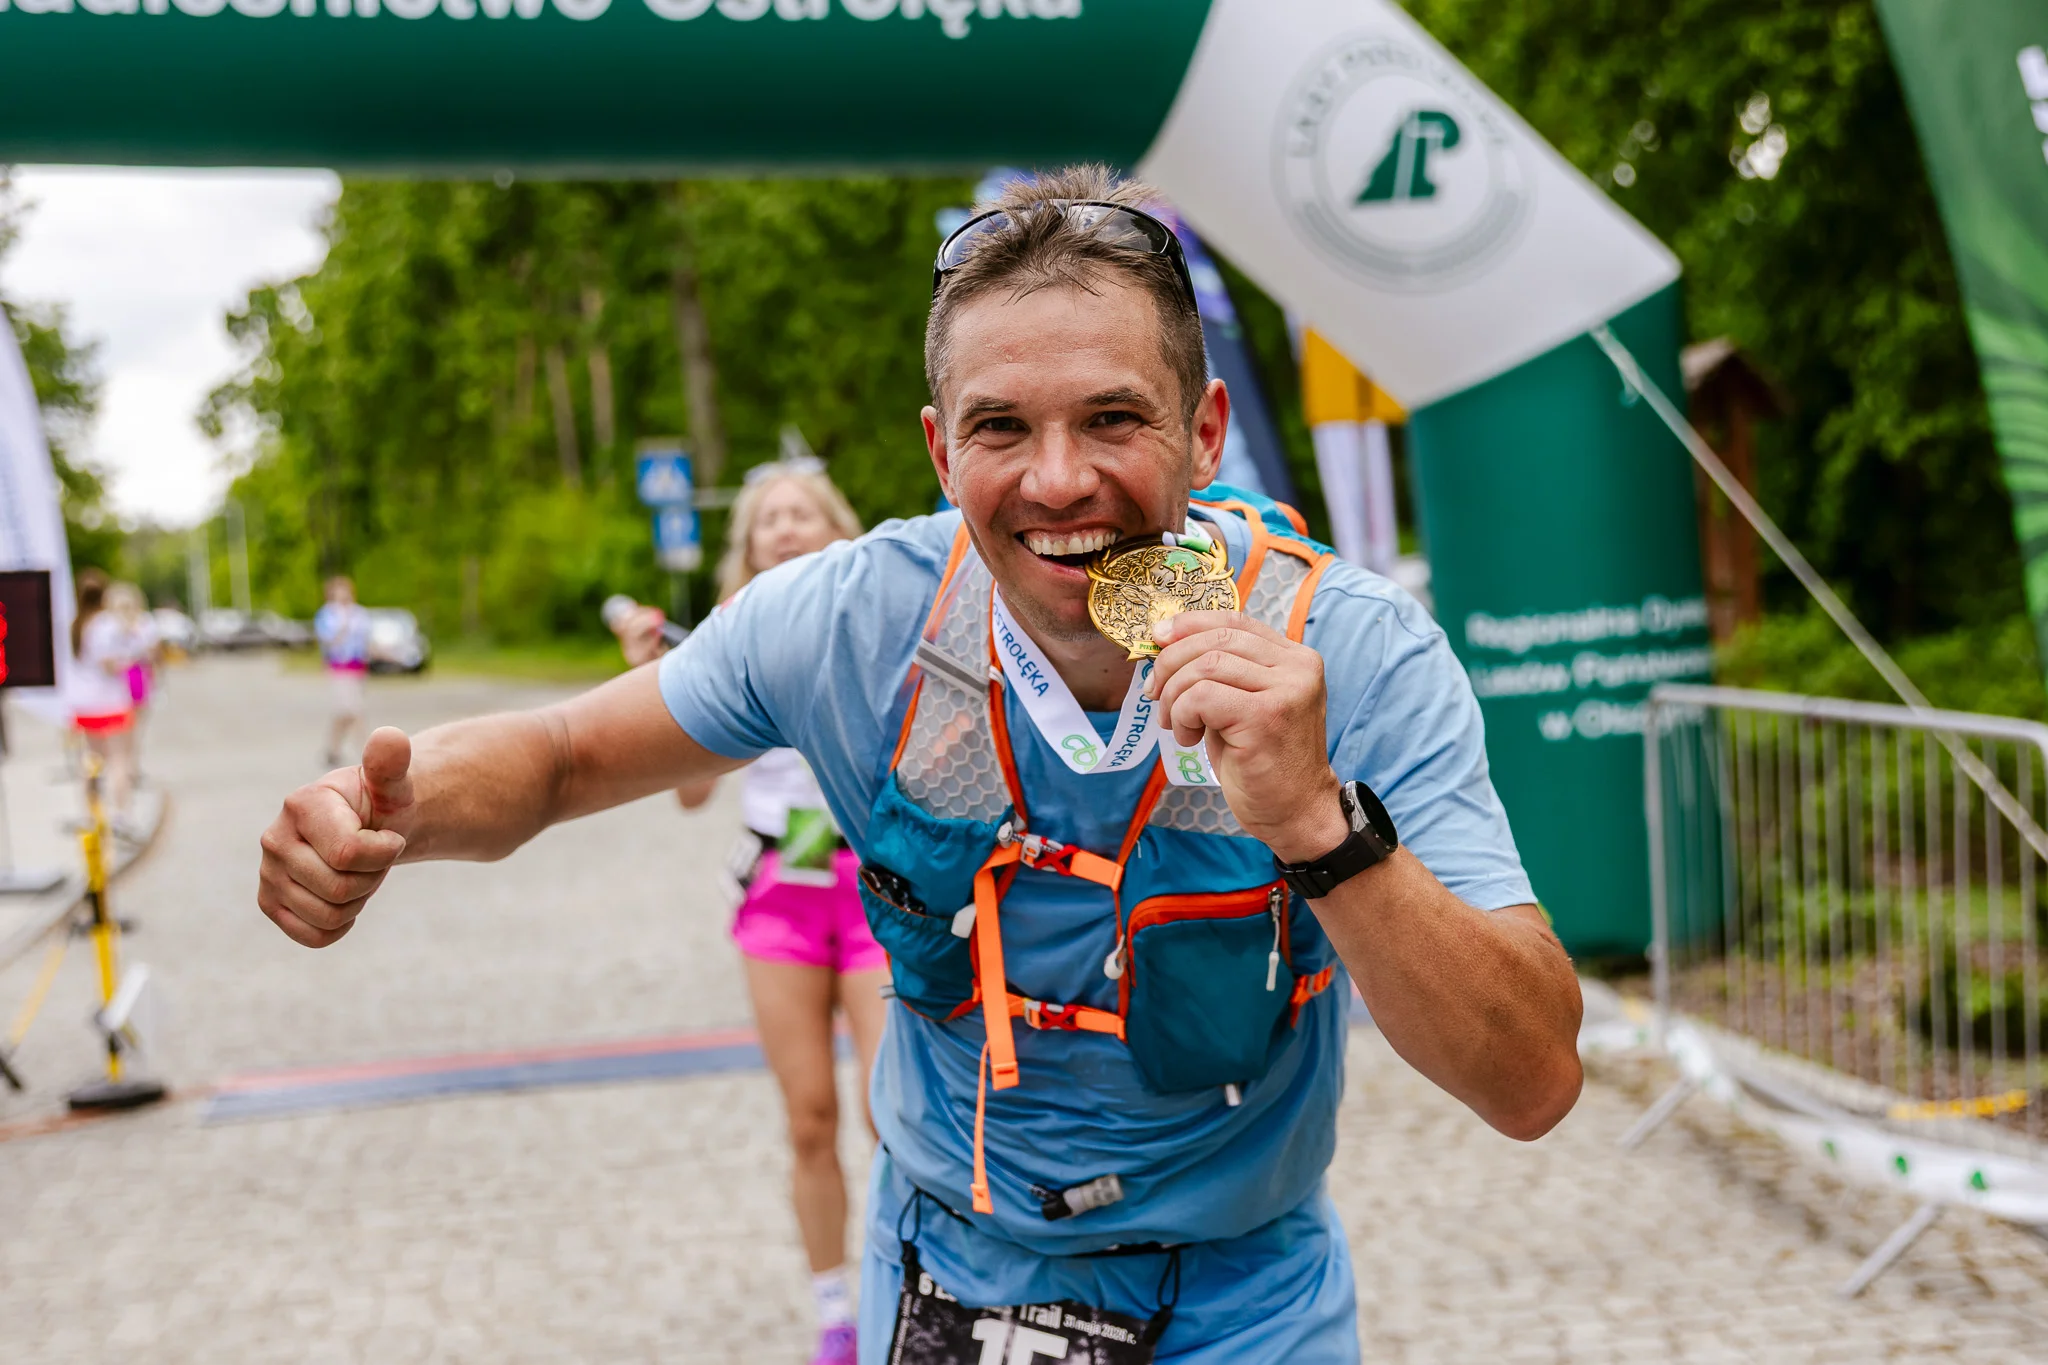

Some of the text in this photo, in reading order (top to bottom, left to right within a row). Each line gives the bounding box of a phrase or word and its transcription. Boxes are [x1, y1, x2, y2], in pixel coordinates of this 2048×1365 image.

[1114, 566, 1165, 590] Love
[1170, 586, 1194, 598] Trail
[918, 1271, 934, 1296] 6
[1075, 1319, 1102, 1337] maja
